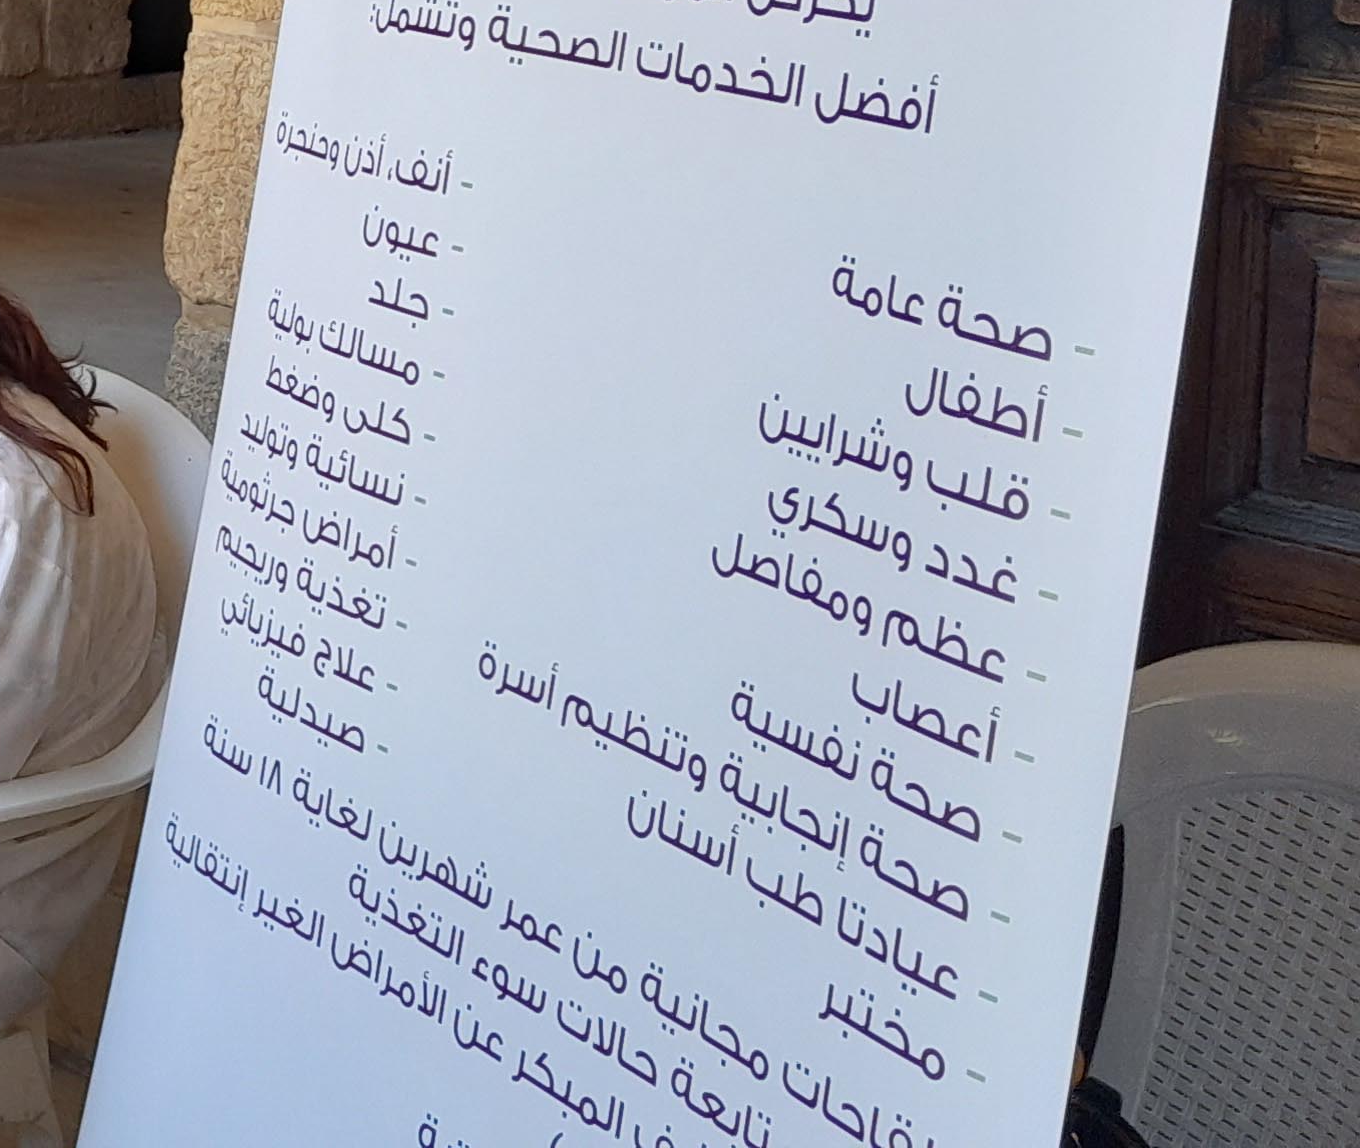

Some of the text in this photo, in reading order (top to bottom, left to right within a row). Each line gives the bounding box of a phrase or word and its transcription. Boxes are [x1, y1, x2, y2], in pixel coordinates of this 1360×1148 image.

[488, 4, 626, 74] الصحية
[636, 39, 806, 109] الخدمات
[276, 111, 340, 171] وحنجرة
[814, 73, 942, 135] أفضل
[343, 132, 386, 181] أذن
[362, 204, 438, 263] عيون
[267, 289, 420, 385] مسالك بولية
[369, 278, 430, 329] جلد
[832, 254, 1053, 362] صحة عامة
[265, 354, 411, 445] كلى وضغط
[905, 366, 1049, 443] أطفال
[240, 412, 404, 507] نسائية وتوليد
[759, 392, 1030, 522] قلب وشرايين
[220, 448, 398, 571] أمراض جرثومية
[768, 486, 1019, 605] غدد وسكري
[214, 521, 386, 630] تغذية وريجيم
[711, 532, 1007, 685] عظم ومفاصل
[220, 590, 375, 694] علاج فيزيائي
[203, 714, 253, 775] سنة
[257, 663, 367, 754] صيدلية
[852, 671, 1002, 764] أعصاب
[259, 755, 282, 796] ١٨
[292, 767, 374, 841] لغاية
[478, 640, 970, 922] صحة إنجابية وتنظيم أسرة
[731, 680, 982, 843] صحة نفسية
[164, 811, 249, 914] إنتقالية
[379, 820, 493, 909] شهرين
[626, 789, 959, 1001] عيادتا طب أسنان
[252, 889, 325, 948] الغير
[348, 863, 465, 965] التغذية
[499, 899, 563, 954] عمر
[331, 931, 448, 1025] الأمراض
[471, 956, 547, 1014] سوء
[573, 931, 628, 994] من
[453, 1003, 504, 1063] عن
[557, 999, 657, 1086] حالات
[640, 961, 769, 1081] مجانية
[818, 983, 946, 1081] مختبر
[511, 1050, 625, 1139] المبكر
